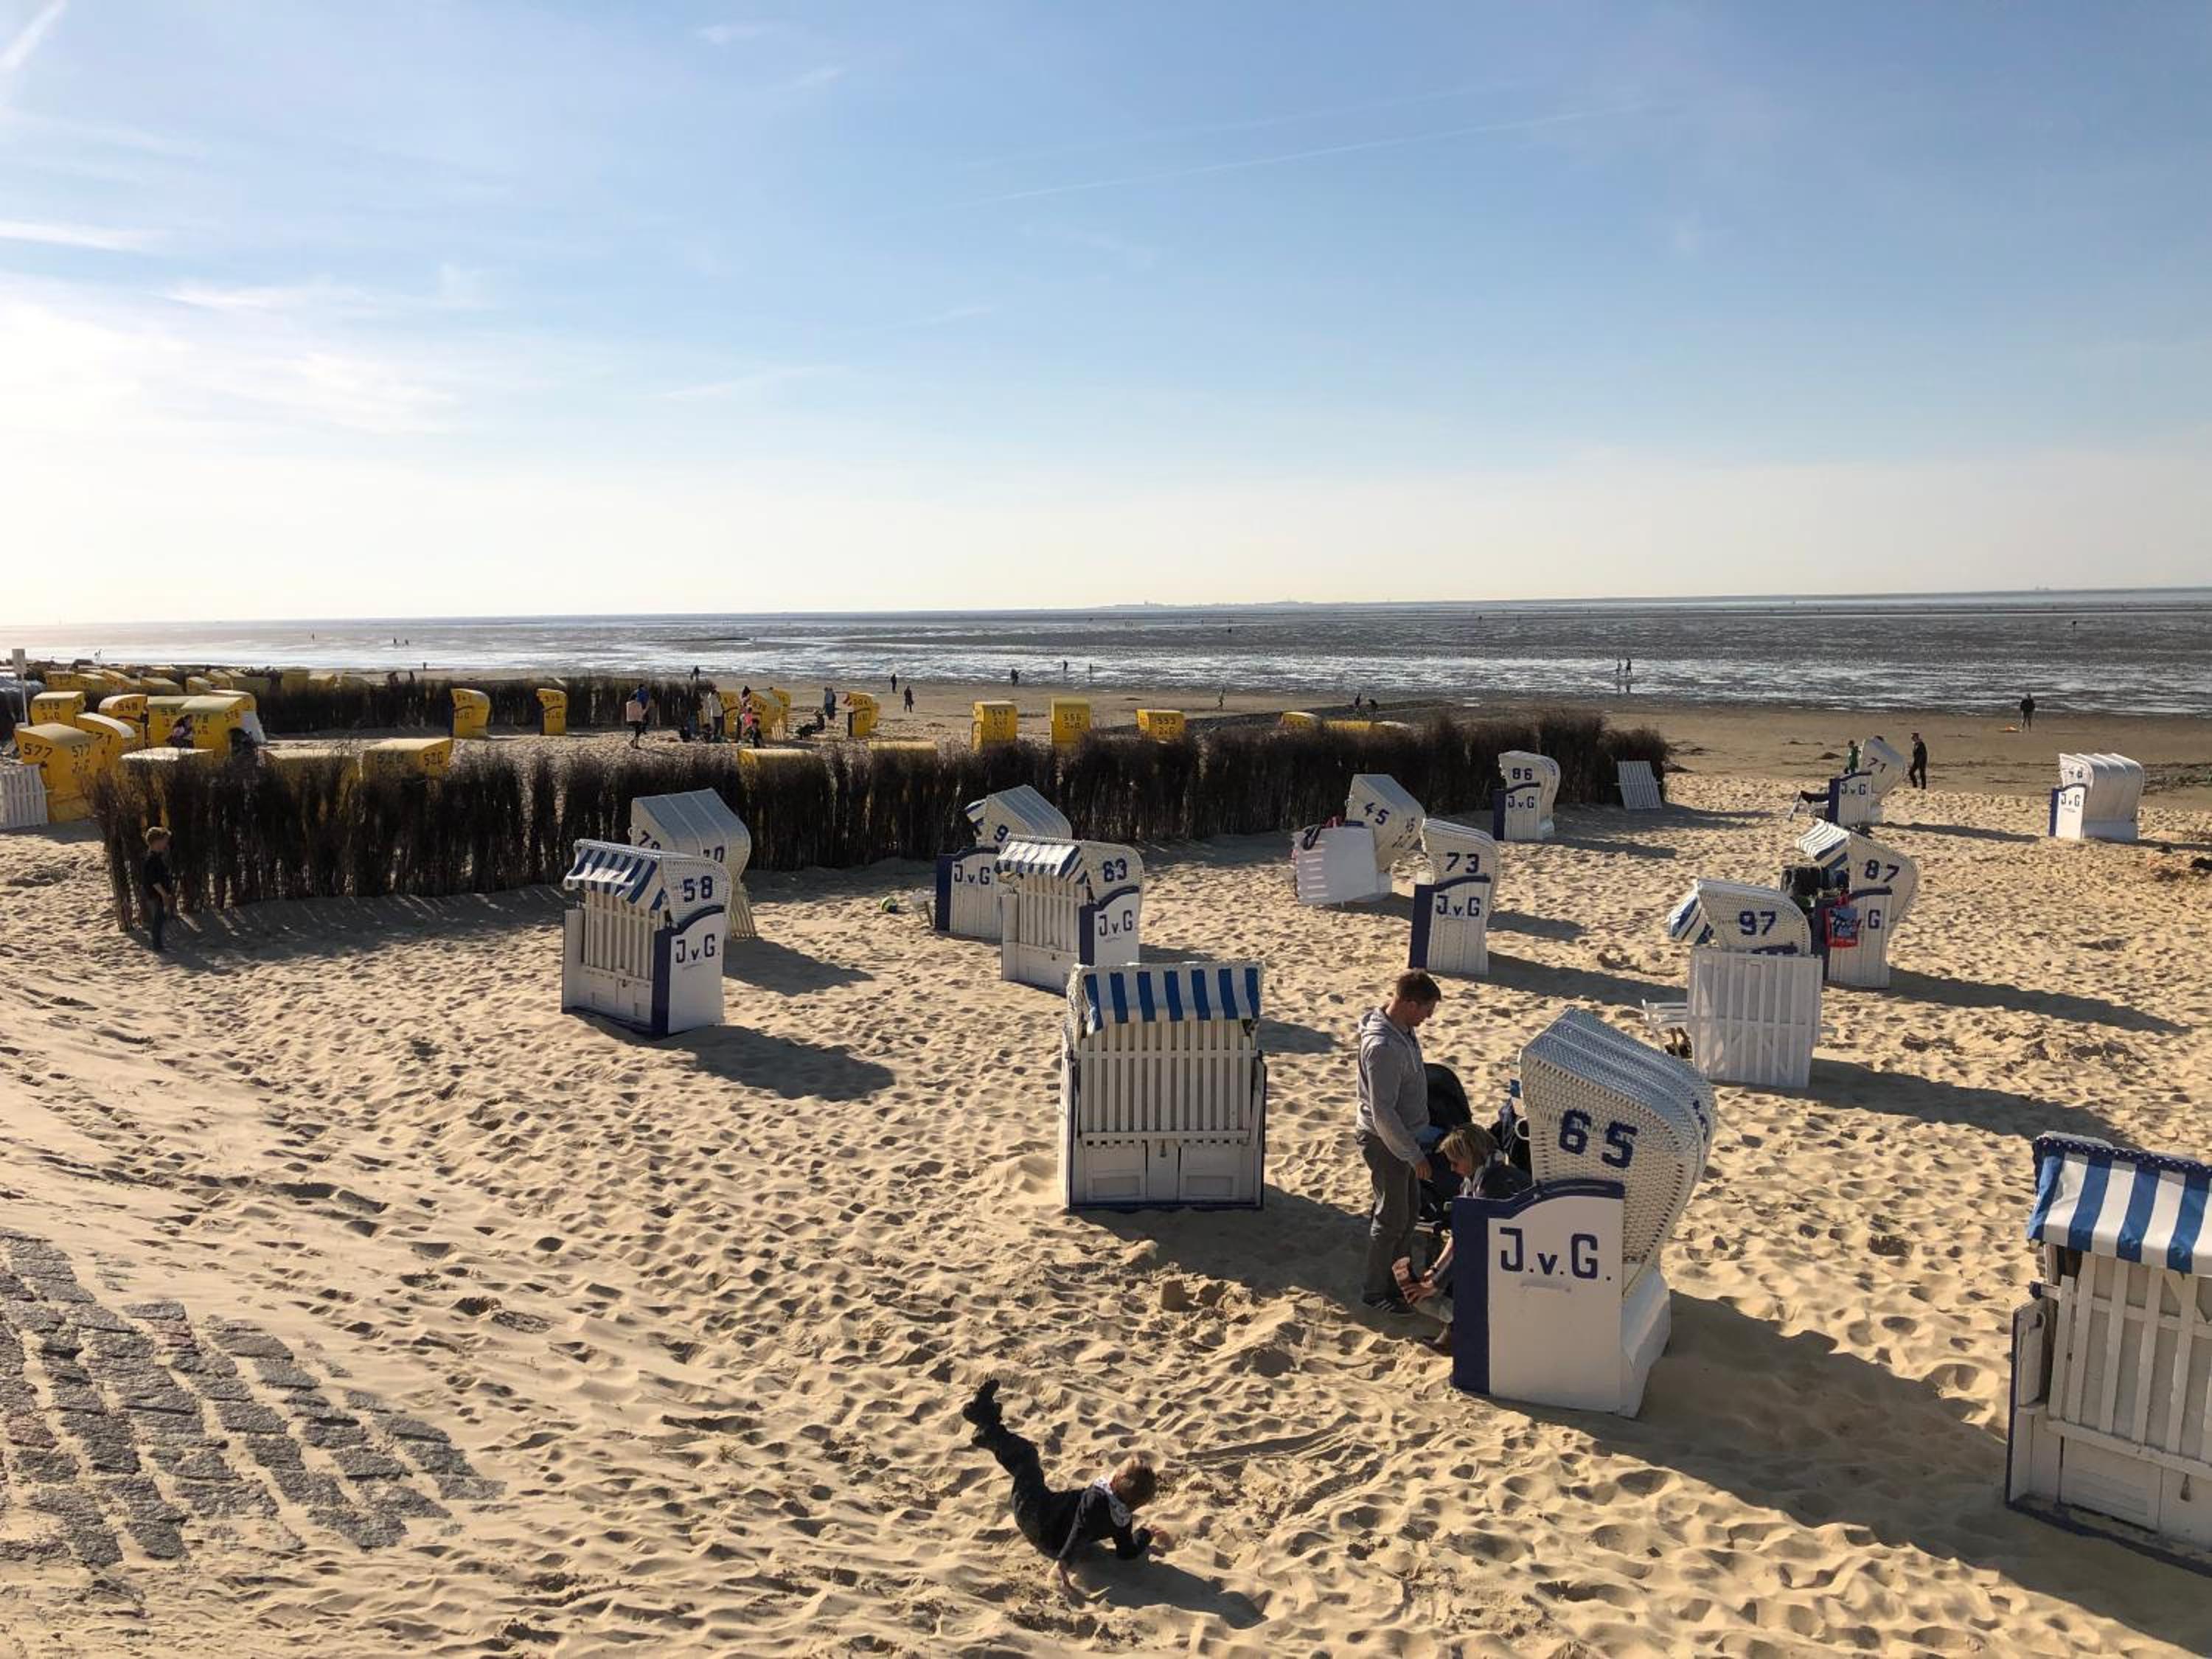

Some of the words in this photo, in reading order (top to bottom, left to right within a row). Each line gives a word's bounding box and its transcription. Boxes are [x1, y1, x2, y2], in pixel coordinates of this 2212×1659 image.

[24, 742, 54, 759] 577
[1512, 768, 1534, 781] 86
[1445, 852, 1480, 874] 73
[1864, 859, 1900, 883] 87
[682, 875, 714, 903] 58
[1738, 911, 1777, 936] 97
[1558, 1107, 1639, 1169] 65
